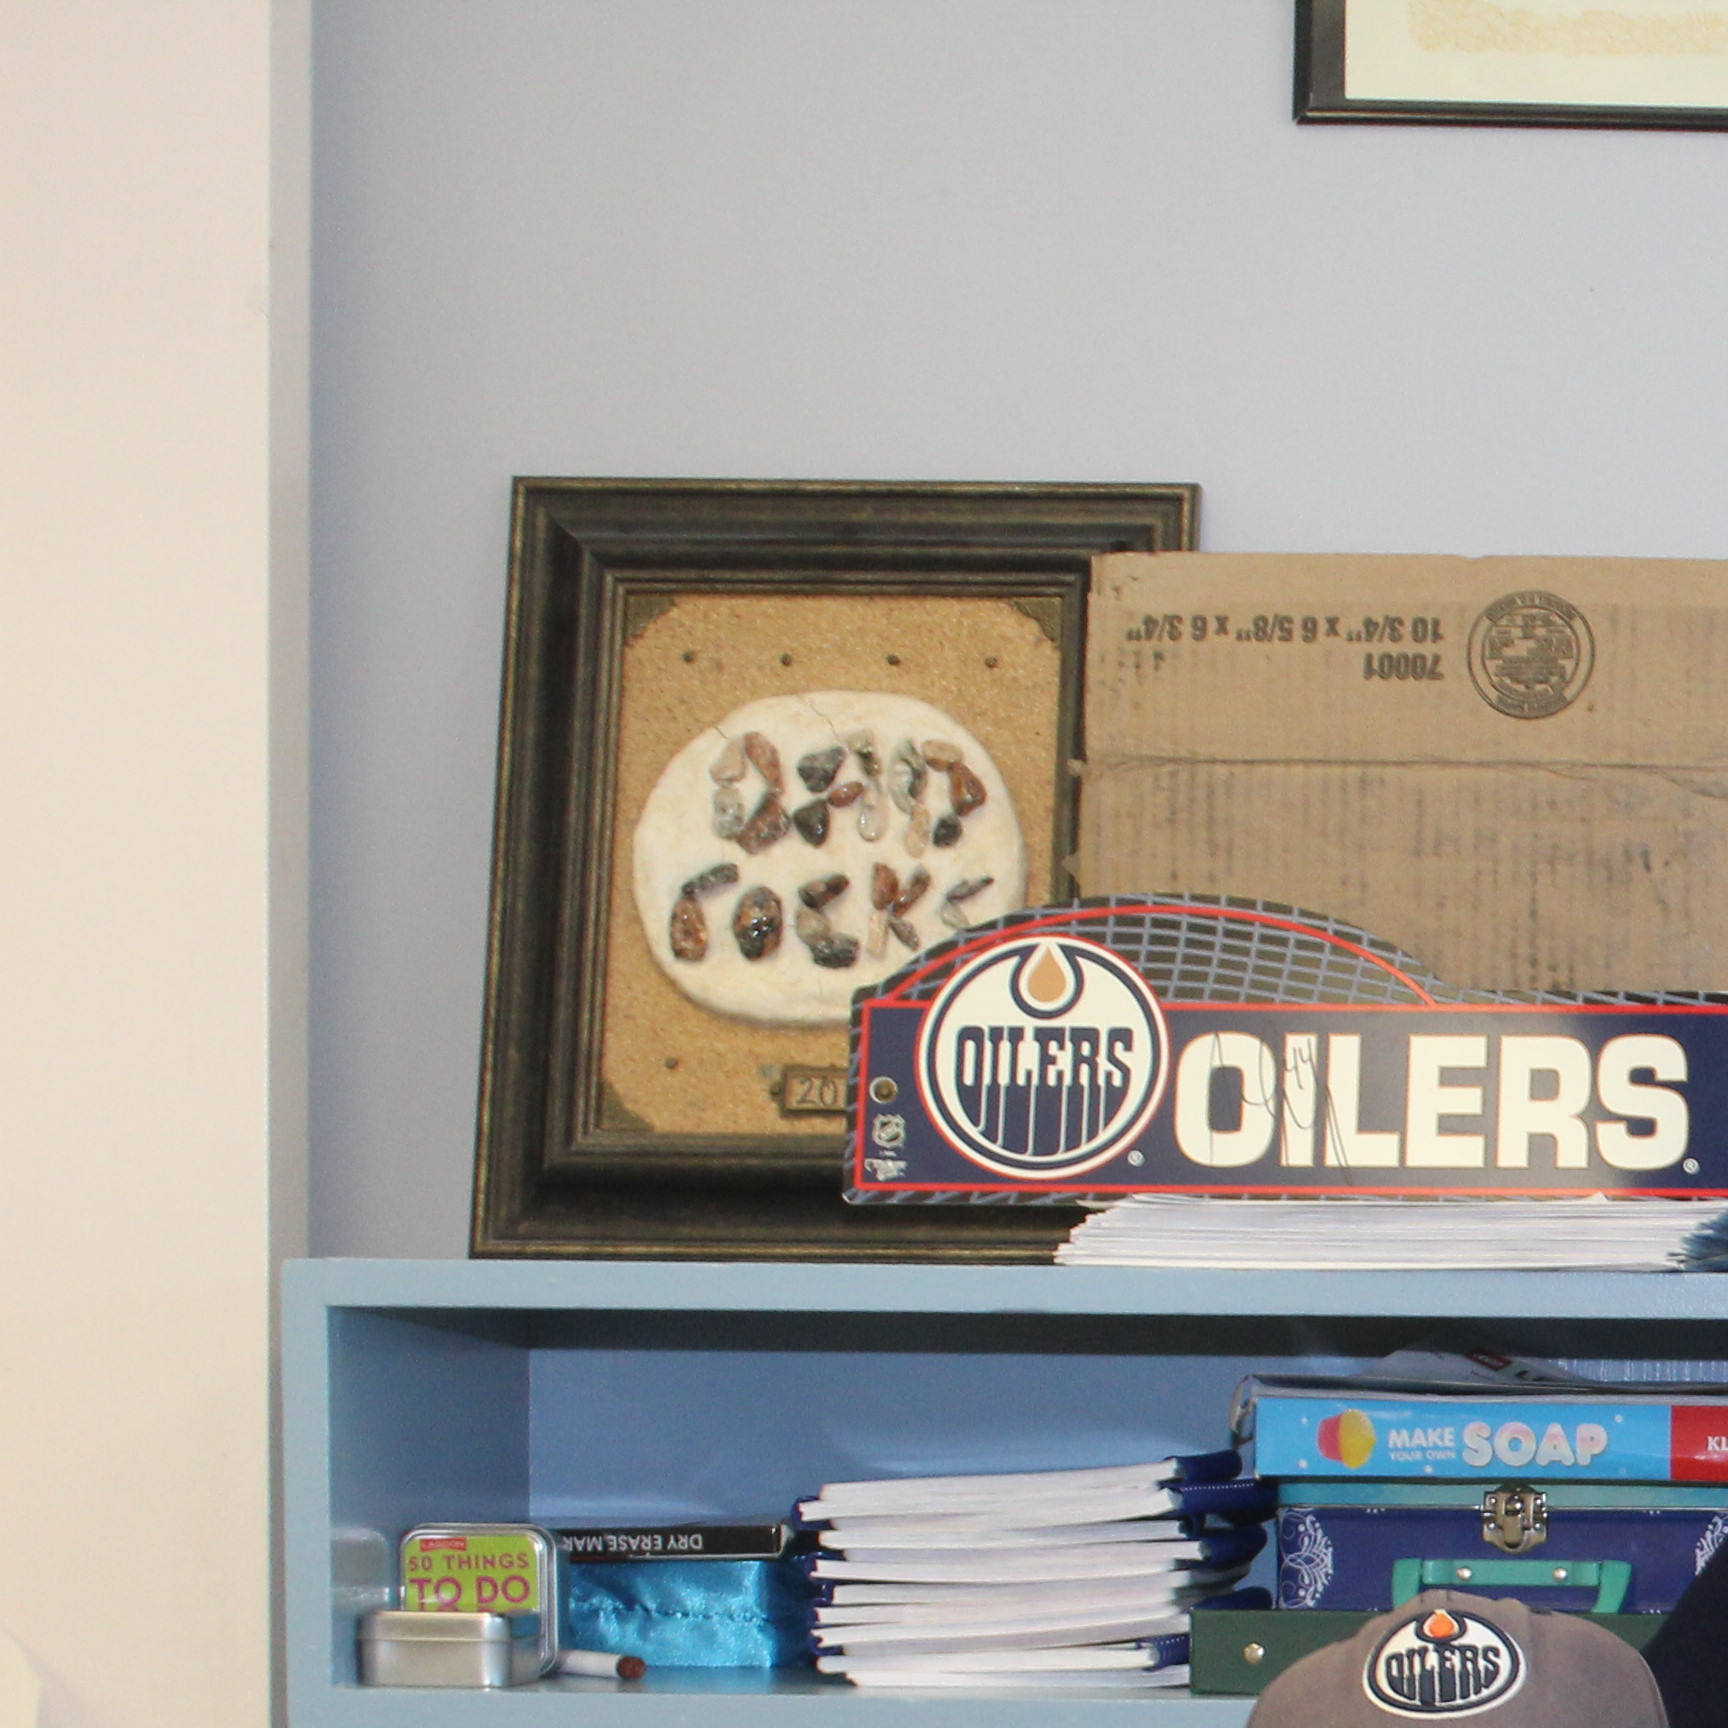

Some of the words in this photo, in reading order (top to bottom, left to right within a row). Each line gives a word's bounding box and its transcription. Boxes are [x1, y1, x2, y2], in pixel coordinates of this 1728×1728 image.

[1191, 615, 1207, 642] 6
[1301, 616, 1317, 642] 6
[1412, 615, 1444, 644] 10
[957, 1026, 1134, 1115] OILERS
[1174, 1032, 1690, 1169] OILERS
[1388, 1427, 1455, 1449] MAKE
[1462, 1421, 1609, 1468] SOAP
[608, 1534, 663, 1553] ERASE
[666, 1533, 703, 1551] DRY
[409, 1556, 434, 1573] 50
[445, 1552, 529, 1570] THINGS
[410, 1577, 464, 1604] TO
[476, 1575, 532, 1604] DO
[1385, 1644, 1502, 1701] OILERS
